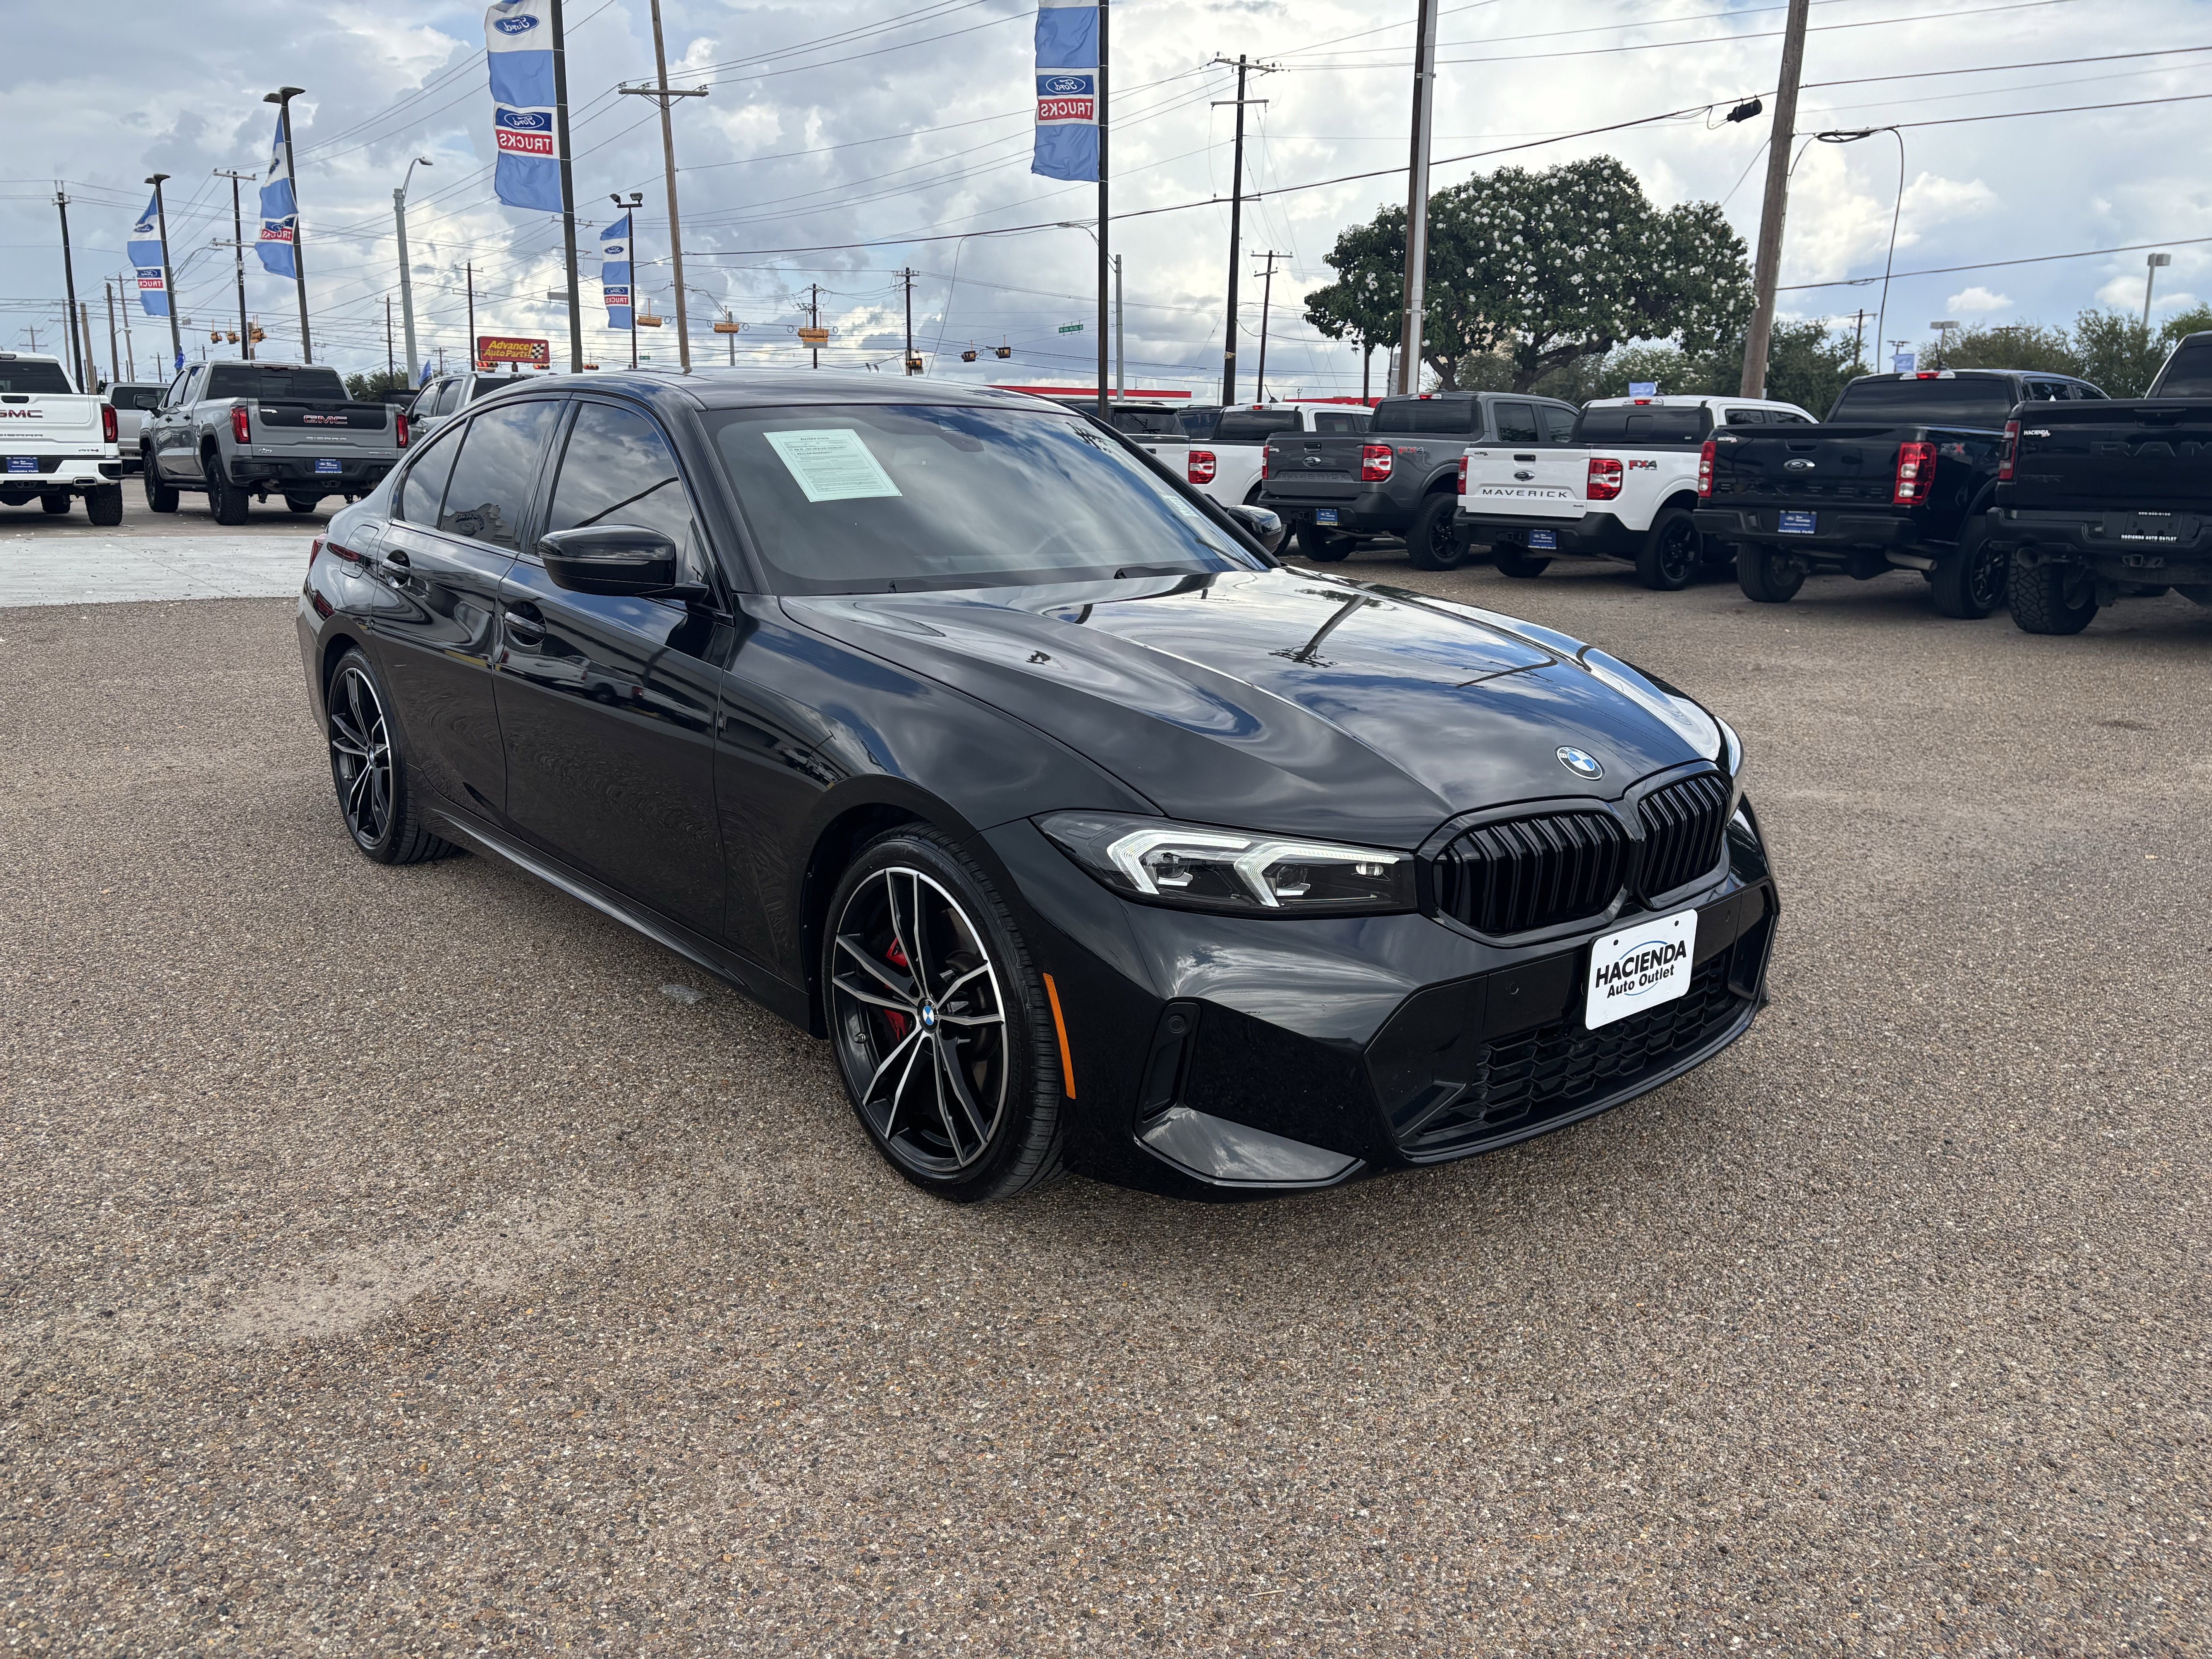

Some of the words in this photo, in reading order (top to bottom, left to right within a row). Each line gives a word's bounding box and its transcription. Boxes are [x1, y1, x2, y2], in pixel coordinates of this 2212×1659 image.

[488, 340, 529, 350] Advance
[303, 415, 348, 424] GMC
[1398, 446, 1424, 455] FX4
[1629, 460, 1657, 470] FX4
[1482, 489, 1568, 498] MAVERICK
[1595, 940, 1686, 988] HACIENDA
[1607, 980, 1635, 998] Auto
[1639, 964, 1674, 987] Outlet
